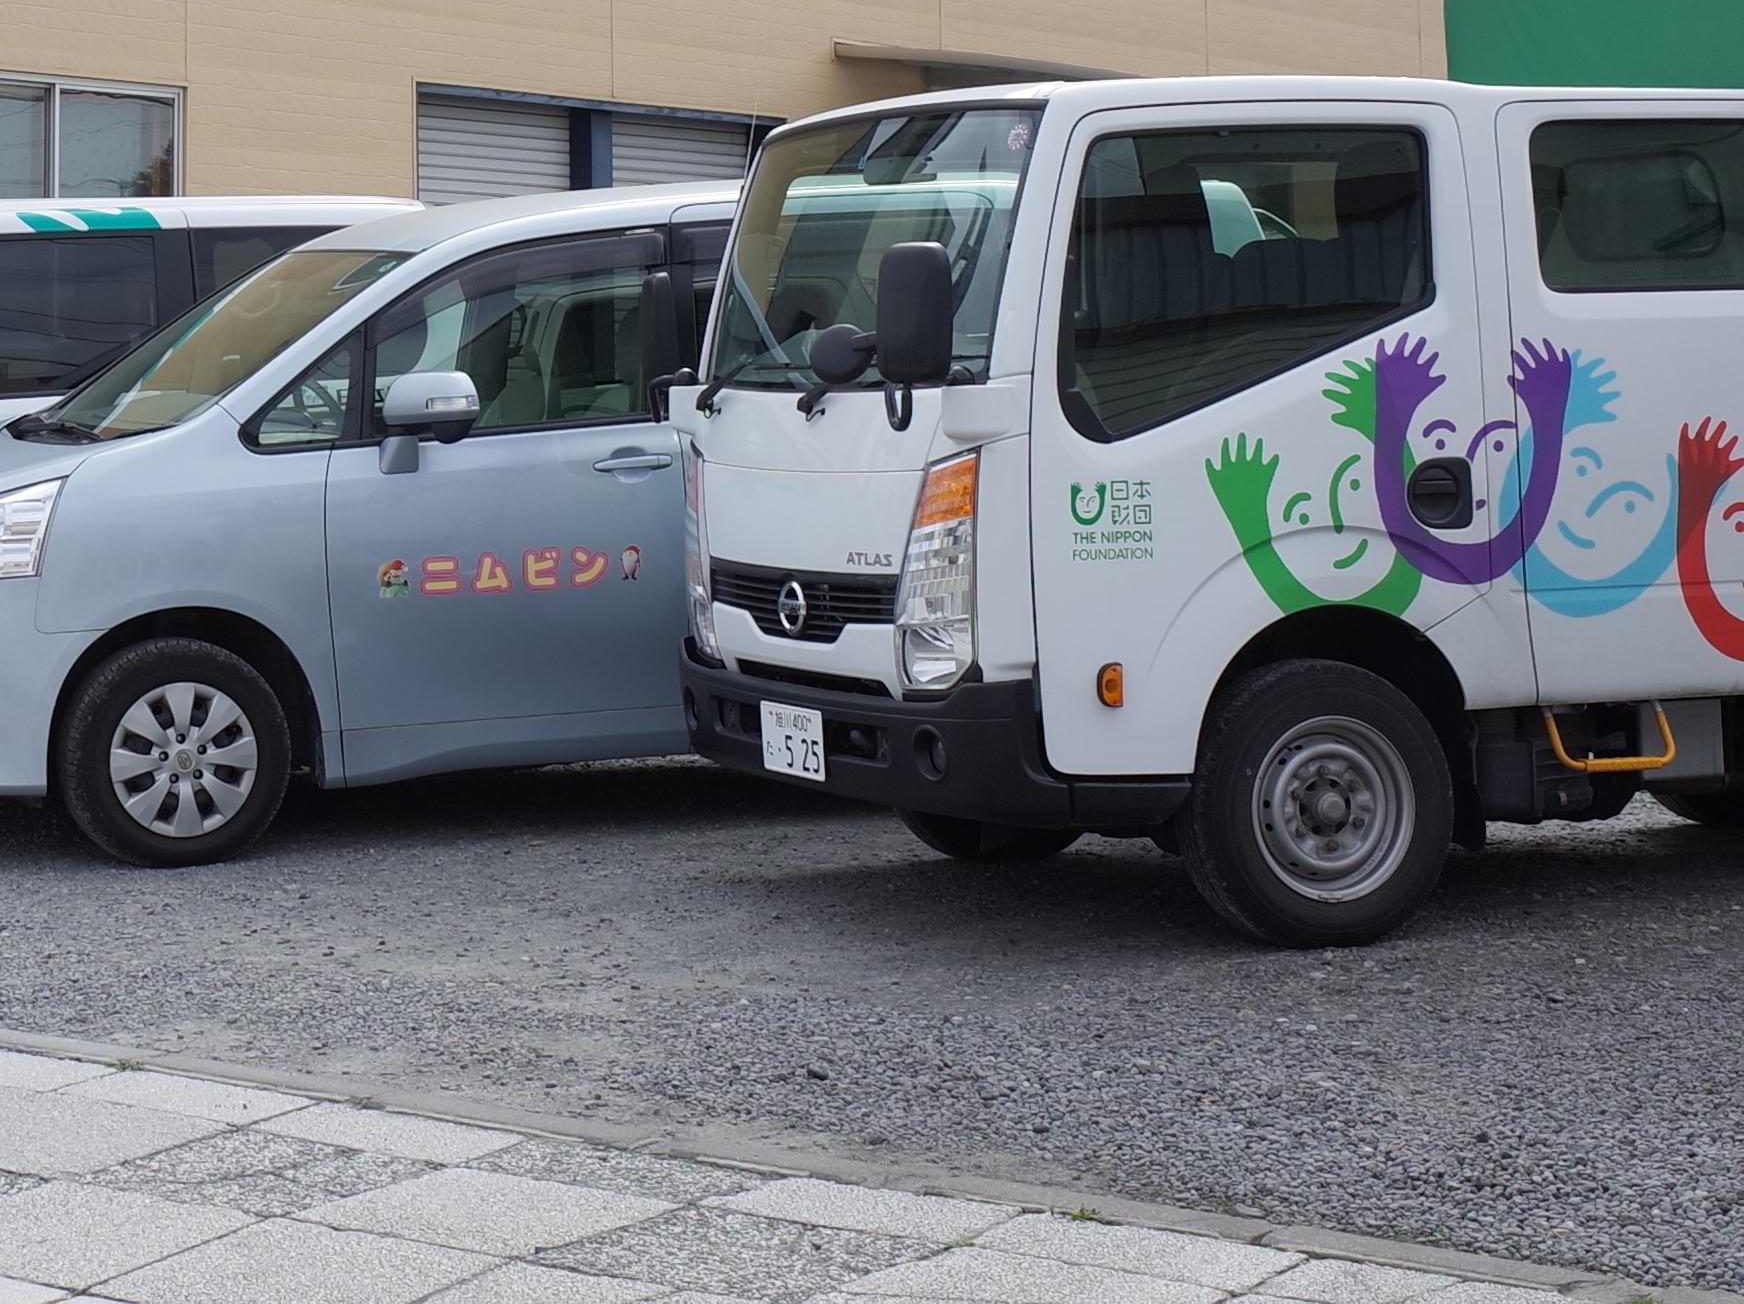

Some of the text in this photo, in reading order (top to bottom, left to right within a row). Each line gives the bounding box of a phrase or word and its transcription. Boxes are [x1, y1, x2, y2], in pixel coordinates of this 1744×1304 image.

[1110, 479, 1152, 500] 日本
[1110, 504, 1152, 526] 財団
[1072, 530, 1153, 545] THE NIPPON
[846, 551, 893, 567] ATLAS
[1072, 547, 1154, 562] FOUNDATION
[420, 546, 610, 595] ニムビン
